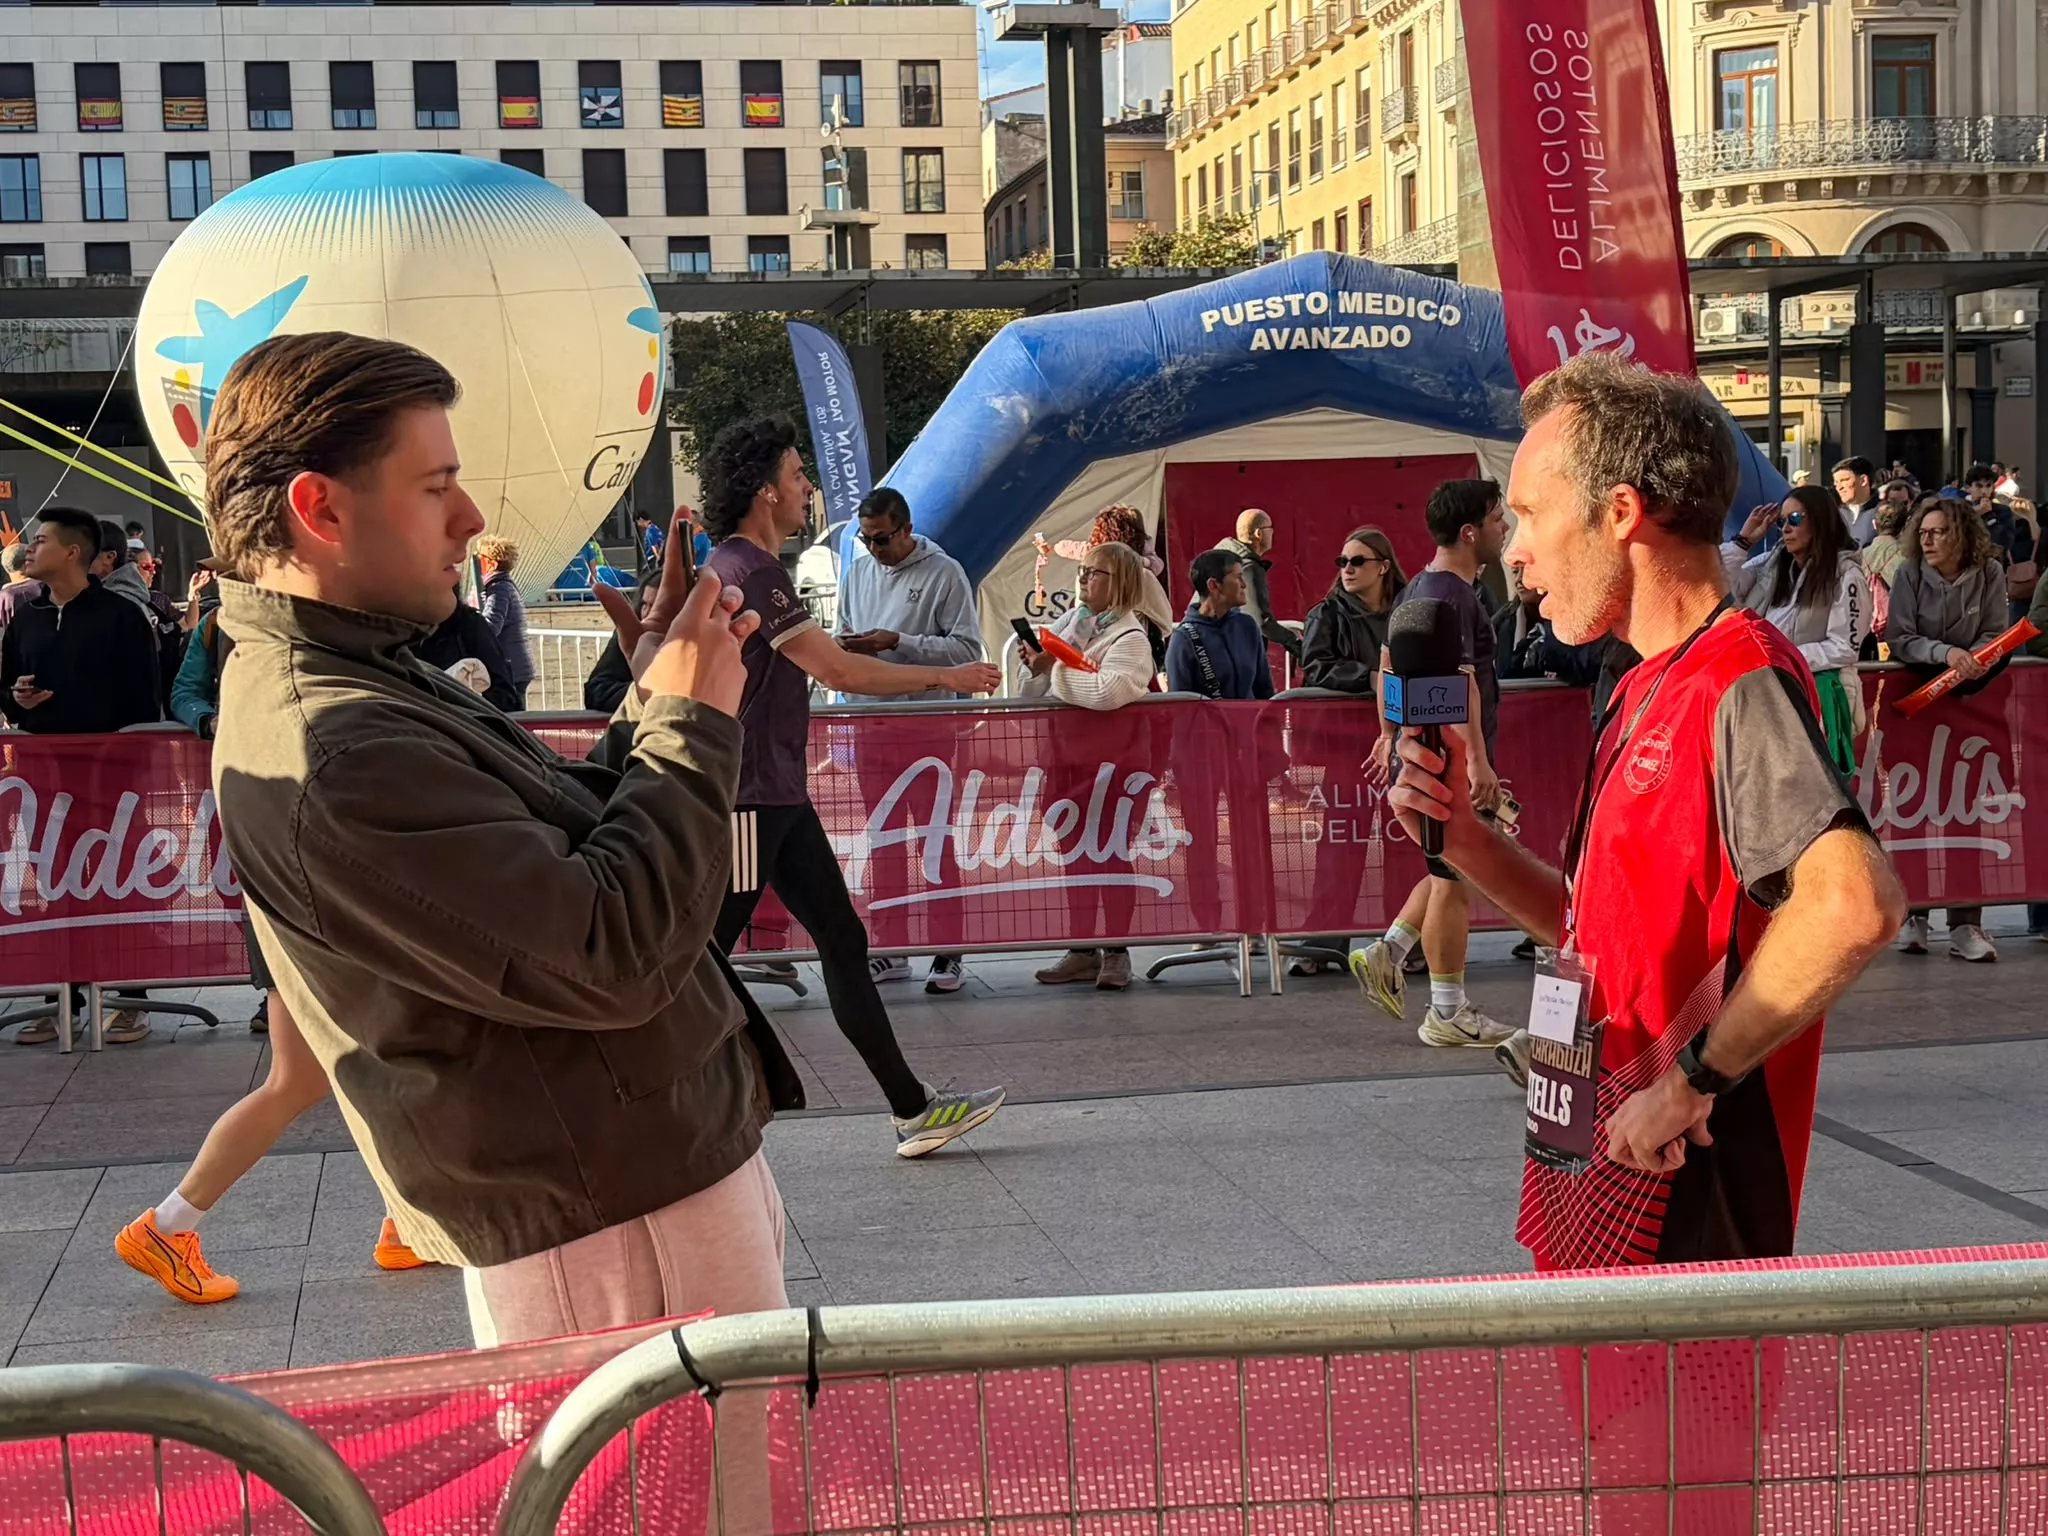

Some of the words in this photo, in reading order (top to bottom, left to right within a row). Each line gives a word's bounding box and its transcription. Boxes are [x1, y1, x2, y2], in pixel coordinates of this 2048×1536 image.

[1200, 291, 1329, 333] PUESTO
[1338, 291, 1462, 326] MEDICO
[1250, 324, 1412, 351] AVANZADO
[583, 444, 640, 492] Cai
[1024, 590, 1076, 620] GS
[1410, 705, 1465, 716] BirdCom
[0, 775, 243, 916] Aldel
